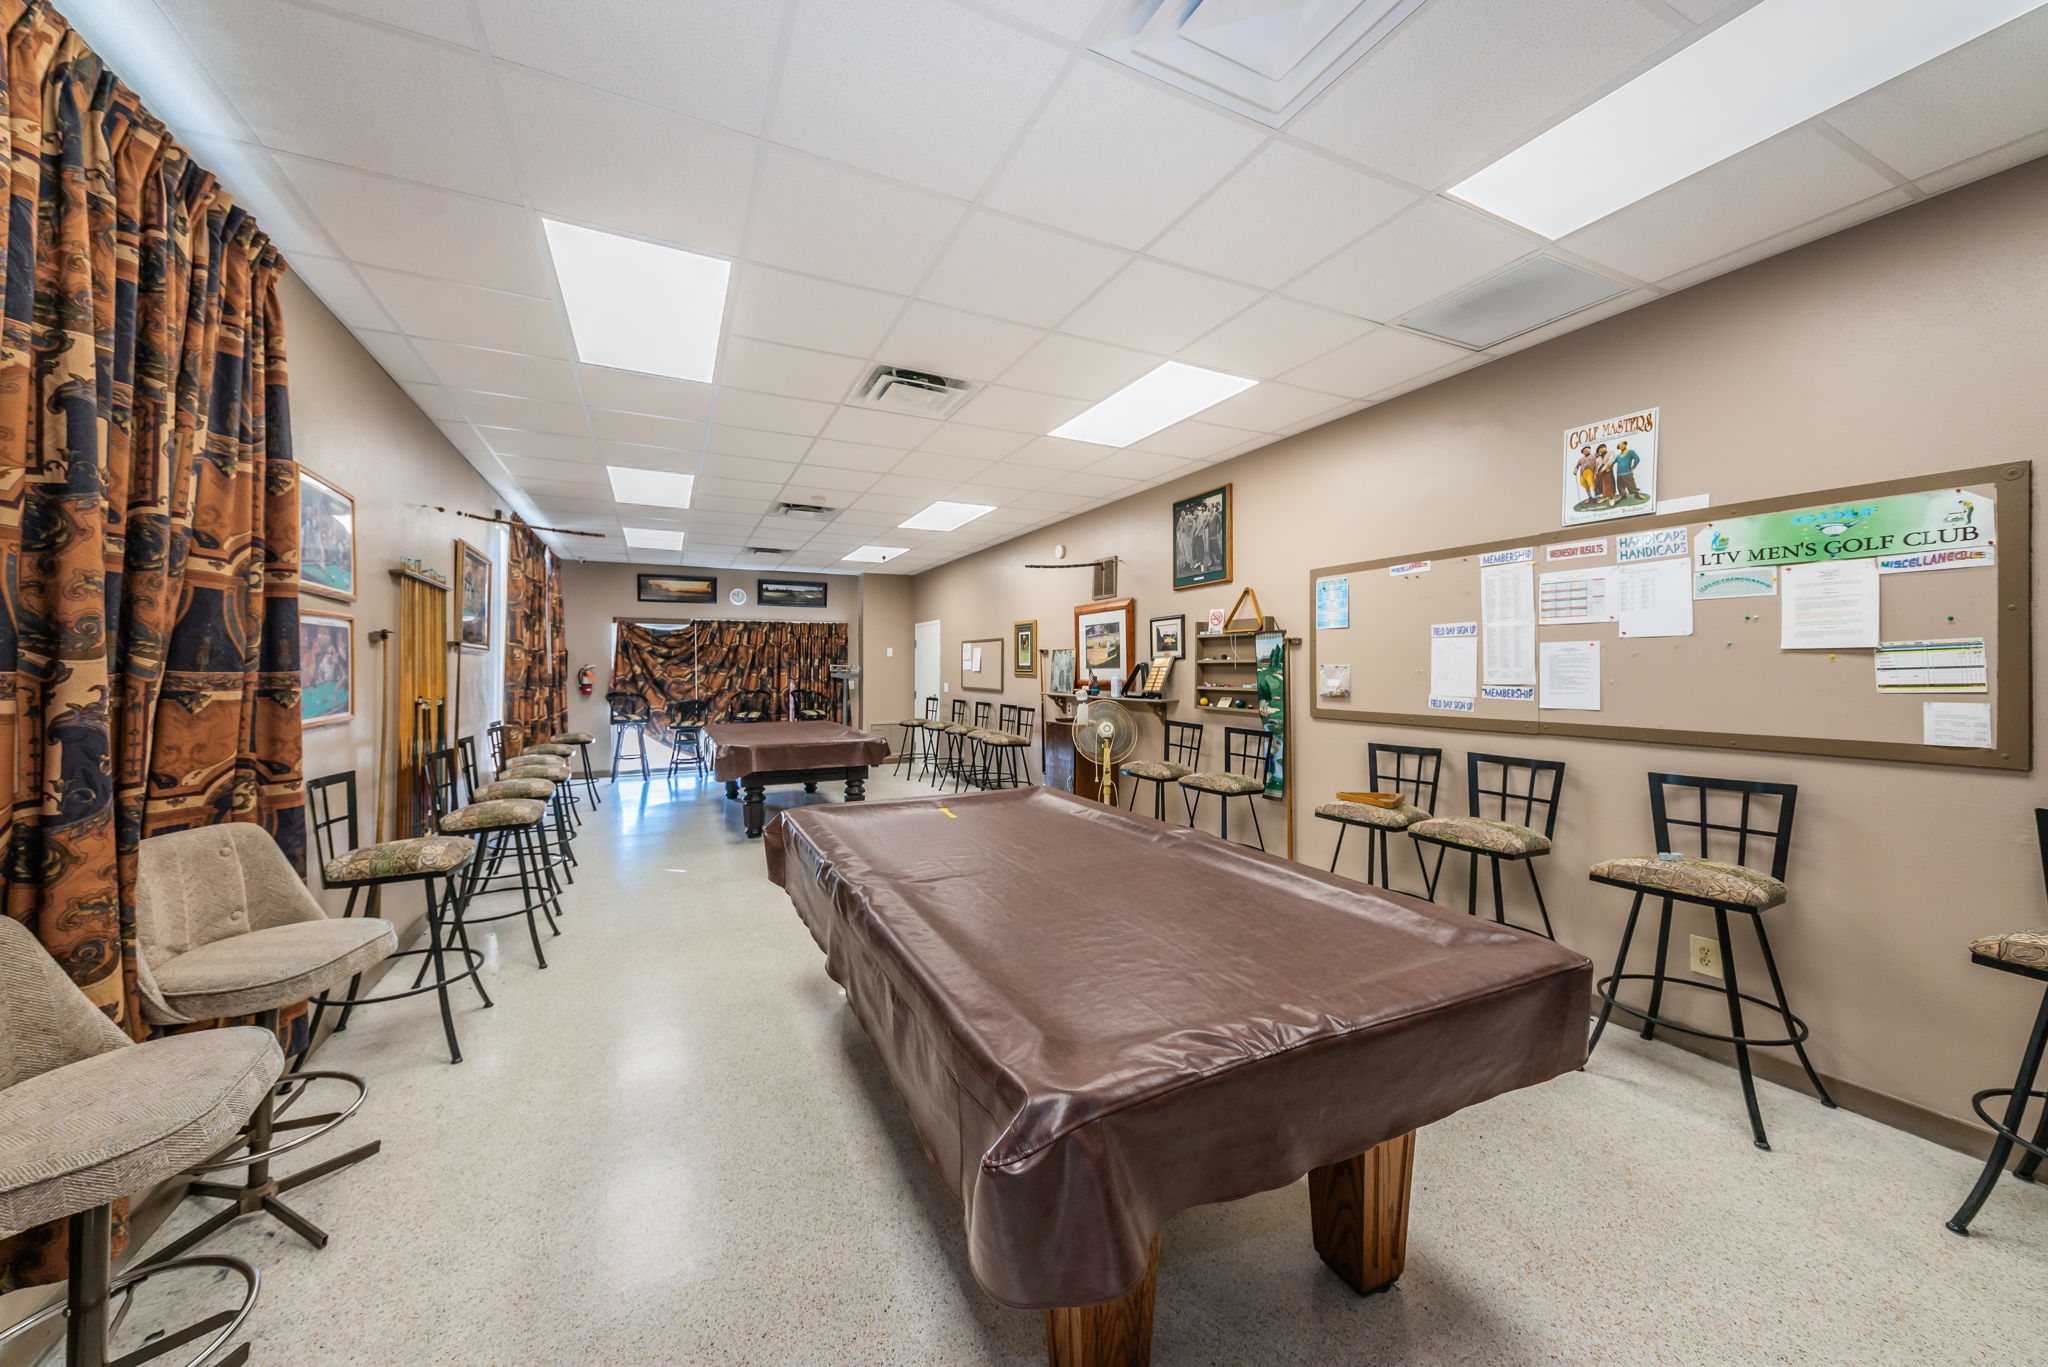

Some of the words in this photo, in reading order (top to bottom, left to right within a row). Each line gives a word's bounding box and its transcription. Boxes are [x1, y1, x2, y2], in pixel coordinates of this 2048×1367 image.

[1569, 426, 1599, 450] GOLF
[1602, 413, 1653, 437] MASTERS
[1791, 505, 1879, 525] GOLF
[1549, 546, 1579, 559] WEDNESDAY
[1620, 542, 1687, 560] HANDICAPS
[1700, 550, 1741, 567] LTV
[1747, 541, 1817, 562] MEN'S
[1824, 534, 1895, 554] GOLF
[1903, 526, 1979, 547] CLUB
[1482, 549, 1532, 565] MEMBERSHIP
[1880, 550, 1987, 569] MISCELLANEOUS
[1433, 626, 1446, 636] FIELD
[1456, 625, 1469, 635] SIGN
[1469, 624, 1477, 634] UP
[1484, 687, 1534, 700] MEMBERSHIP
[1453, 700, 1466, 710] SIGN
[1466, 701, 1474, 711] UP
